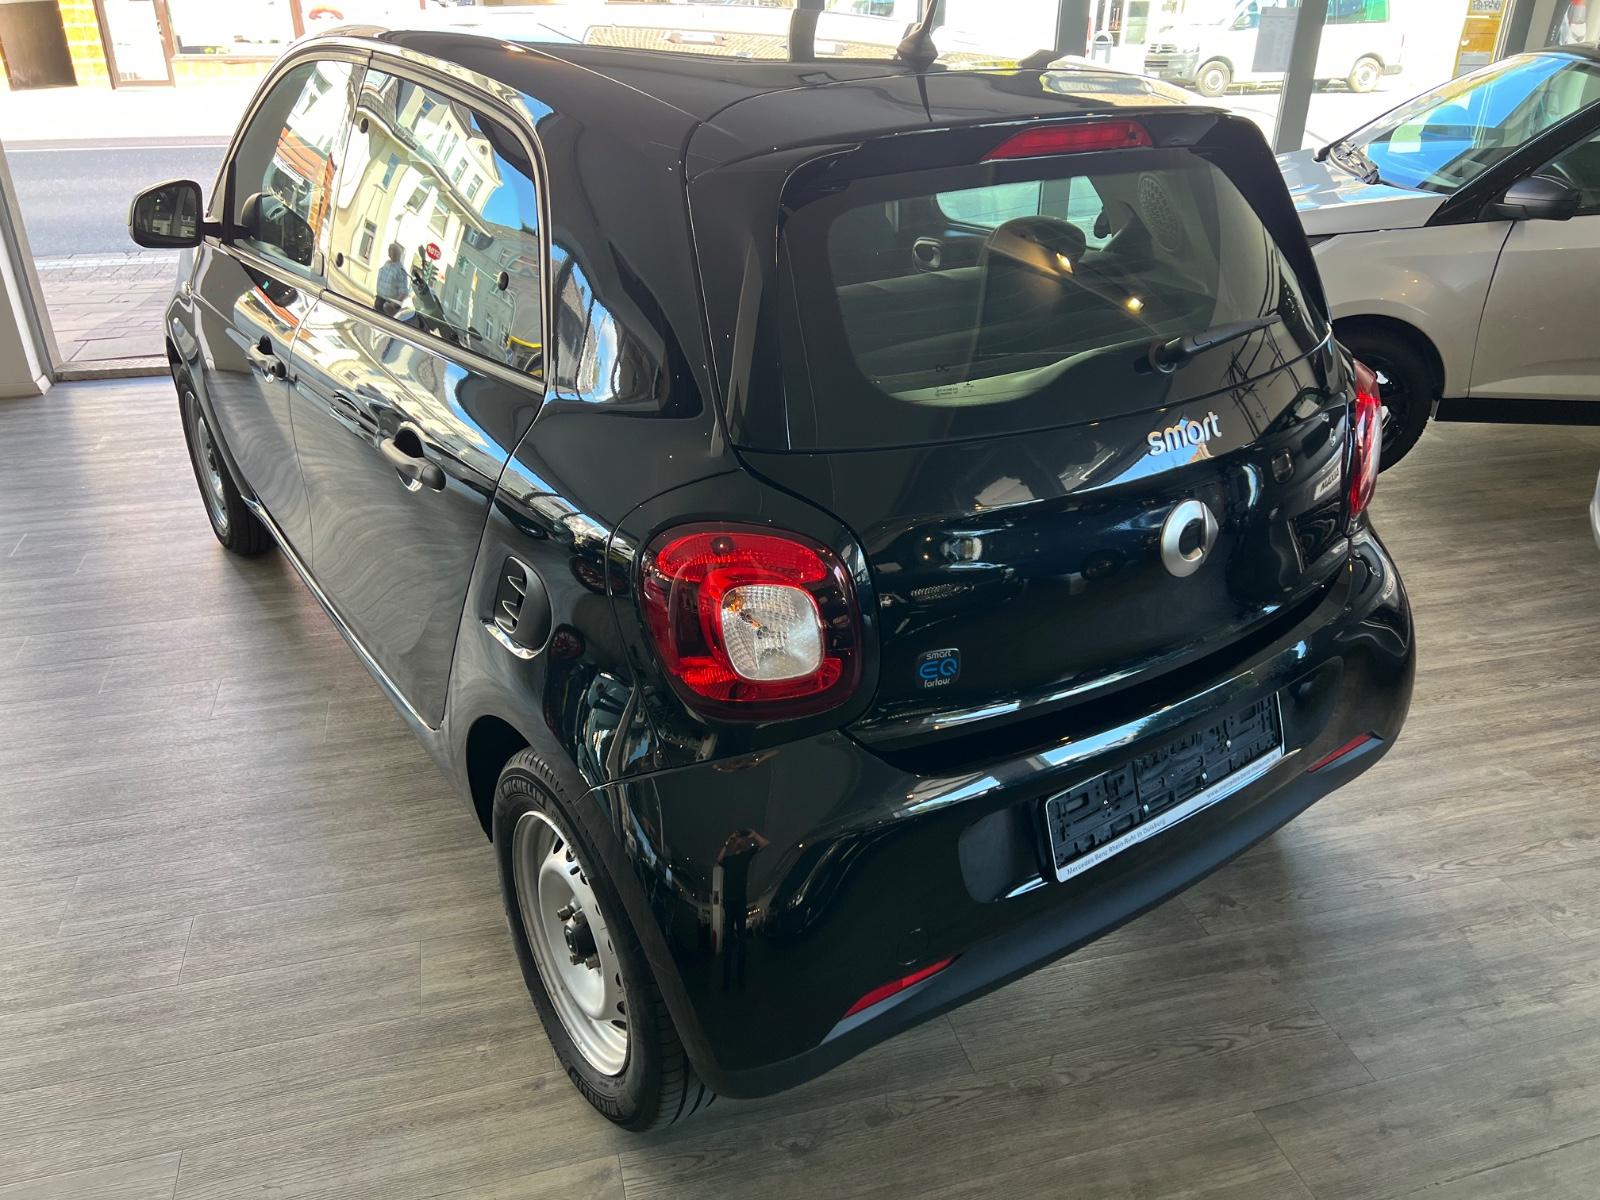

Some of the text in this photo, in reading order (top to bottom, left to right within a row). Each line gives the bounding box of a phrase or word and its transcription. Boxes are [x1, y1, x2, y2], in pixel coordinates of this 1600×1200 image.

[1147, 411, 1222, 456] smart
[926, 650, 952, 661] smart
[919, 658, 958, 679] EQ
[924, 678, 951, 689] forfour
[502, 779, 547, 809] MICHELIN
